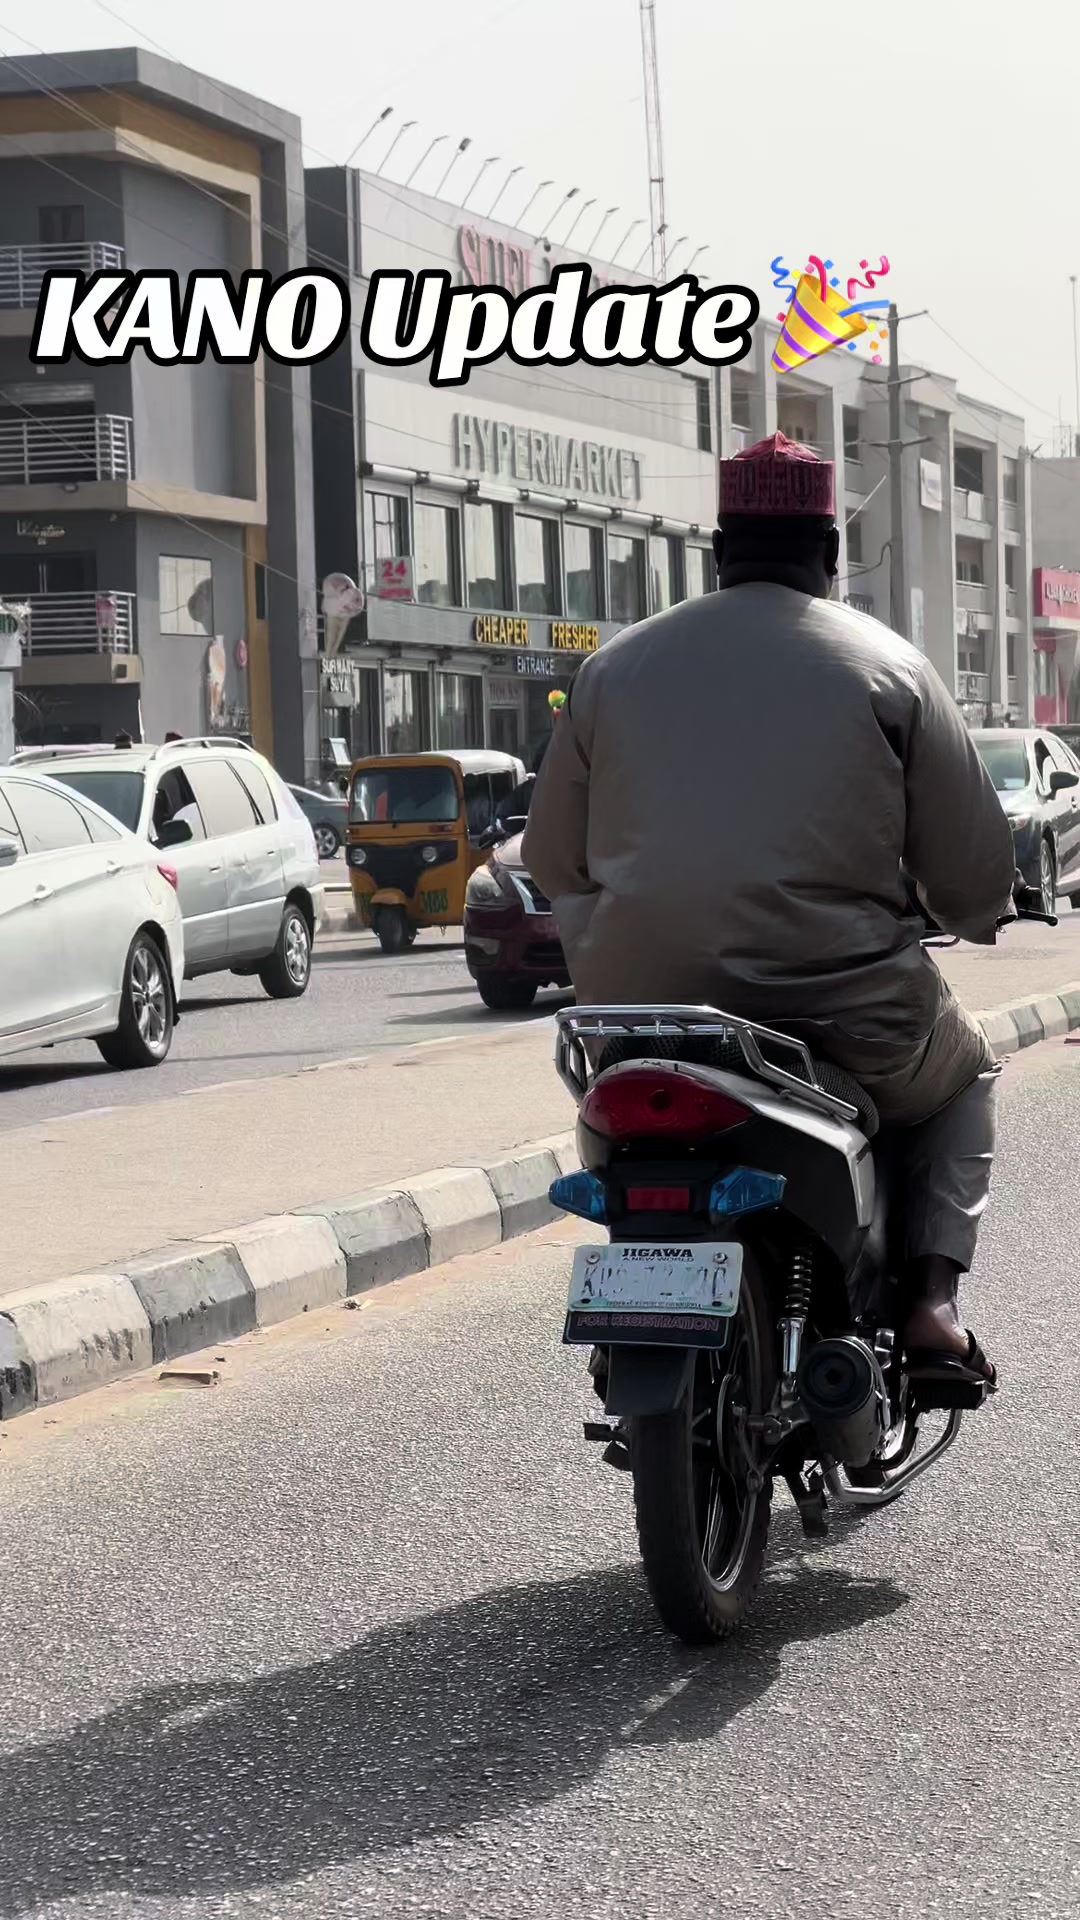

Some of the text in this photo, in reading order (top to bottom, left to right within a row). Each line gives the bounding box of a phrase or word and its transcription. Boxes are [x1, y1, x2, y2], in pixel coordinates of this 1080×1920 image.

[452, 412, 645, 502] HYPERMARKET
[382, 560, 406, 578] 24
[550, 621, 600, 652] FRESHER
[516, 655, 556, 676] ENTRANCE
[621, 1247, 694, 1258] JIGAWA
[577, 1314, 720, 1331] FOR REGISTRATION
